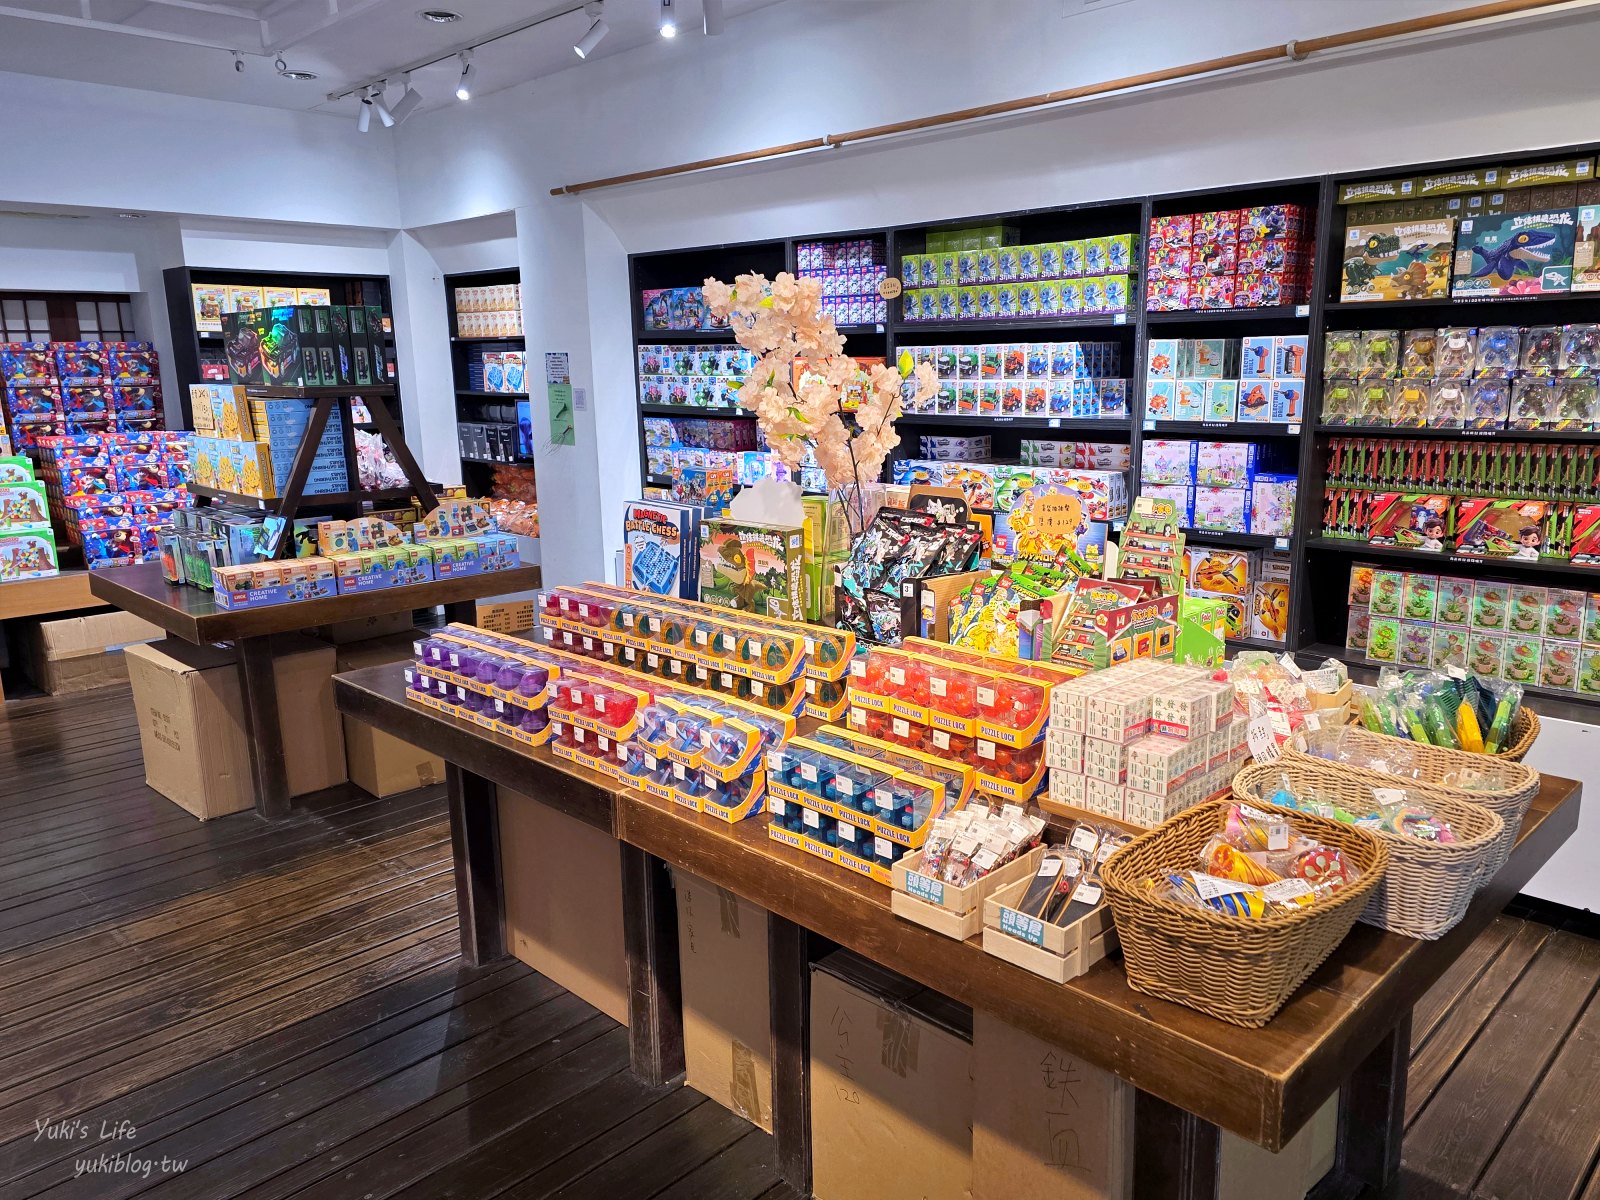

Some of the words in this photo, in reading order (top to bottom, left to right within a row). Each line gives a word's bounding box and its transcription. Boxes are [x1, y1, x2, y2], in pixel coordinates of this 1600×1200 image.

[633, 509, 668, 524] MAGNETIC
[626, 520, 651, 532] BATTLE
[652, 523, 678, 539] CHESS
[855, 694, 871, 705] PUZZLE
[872, 699, 883, 707] LOCK
[894, 704, 909, 715] PUZZLE
[911, 709, 922, 719] LOCK
[934, 716, 950, 727] PUZZLE
[952, 721, 965, 731] LOCK
[981, 727, 999, 738] PUZZLE
[1001, 732, 1015, 742] LOCK
[771, 785, 785, 796] PUZZLE
[787, 790, 798, 800] LOCK
[981, 779, 999, 791] PUZZLE
[1001, 785, 1015, 795] LOCK
[804, 796, 819, 808] PUZZLE
[821, 803, 833, 813] LOCK
[839, 809, 856, 822] PUZZLE
[858, 816, 870, 827] LOCK
[771, 830, 786, 842] PUZZLE
[788, 836, 799, 845] LOCK
[877, 825, 895, 838] PUZZLE
[896, 833, 910, 843] LOCK
[805, 841, 820, 854] PUZZLE
[822, 848, 834, 858] LOCK
[840, 855, 856, 868] PUZZLE
[858, 862, 870, 873] LOCK
[907, 872, 943, 897] 頭等倉
[908, 886, 929, 899] Heads
[930, 894, 940, 903] Up
[1002, 909, 1043, 936] 頭等倉
[1002, 925, 1026, 939] Heads
[1027, 933, 1038, 943] Up
